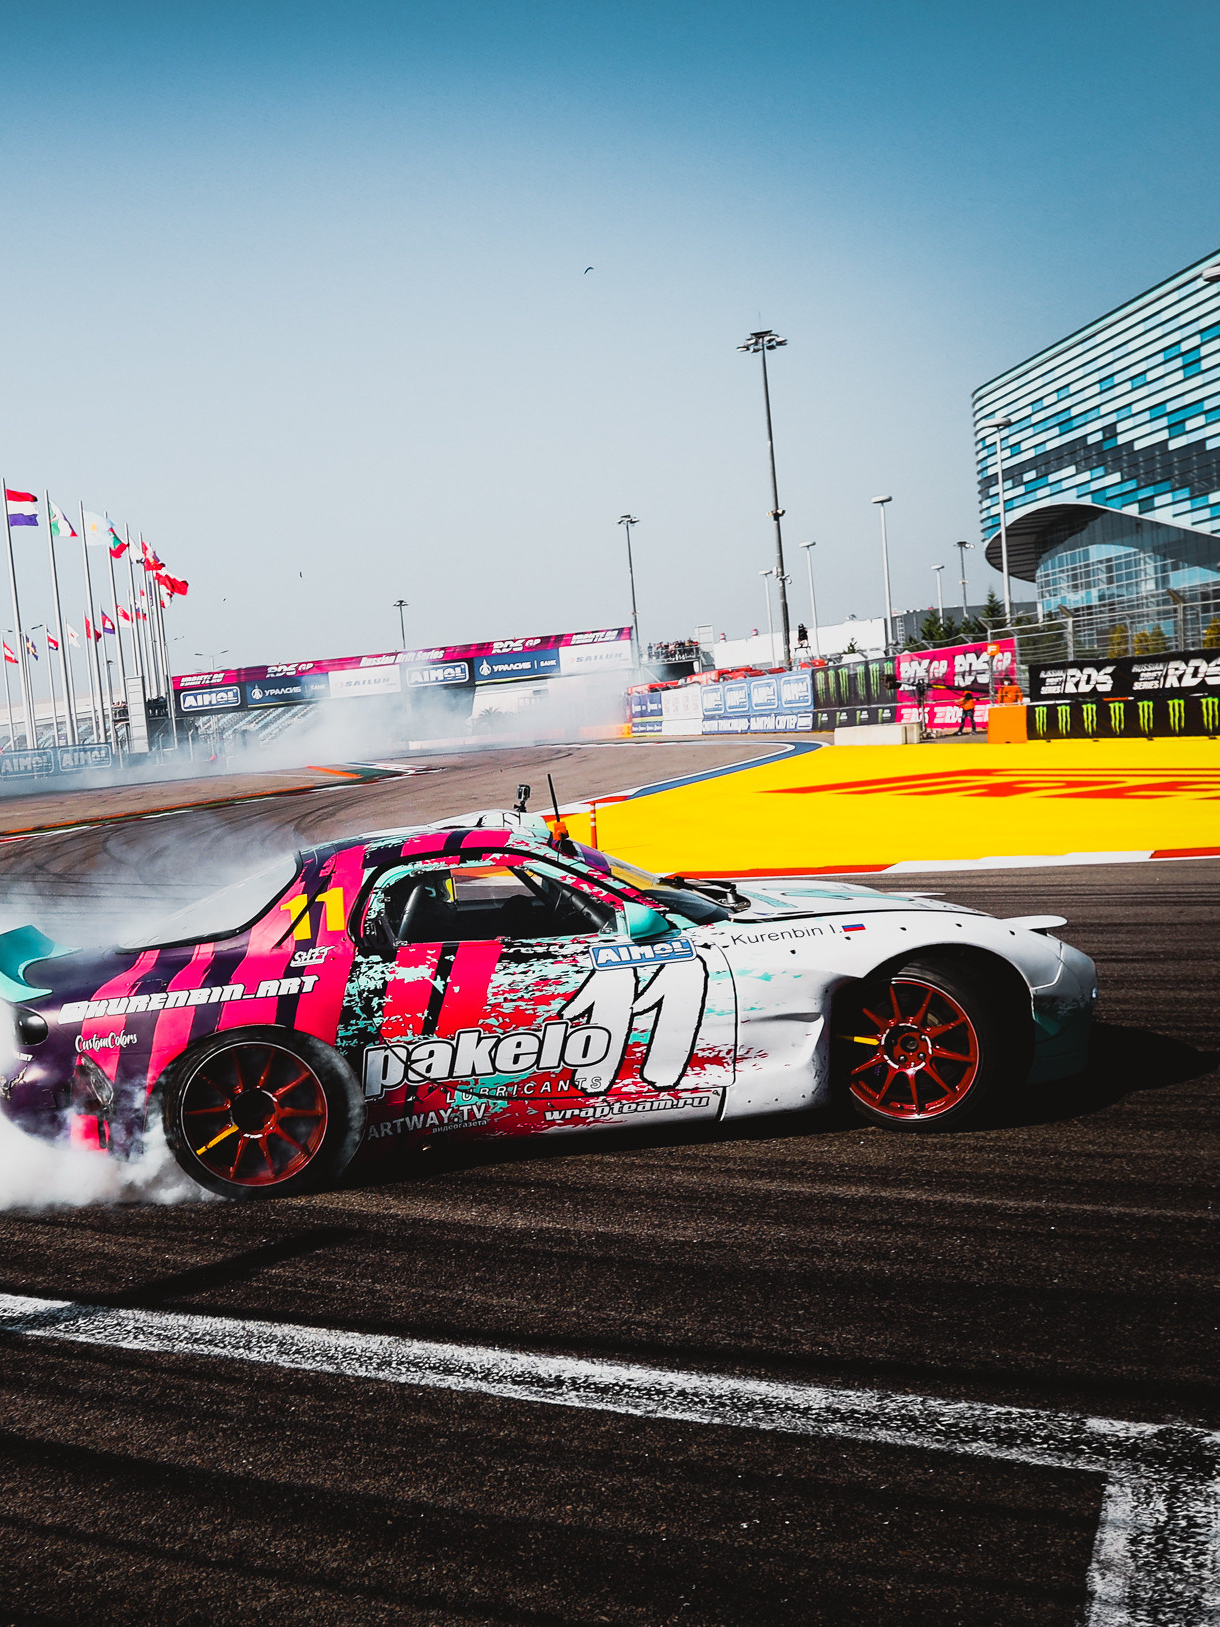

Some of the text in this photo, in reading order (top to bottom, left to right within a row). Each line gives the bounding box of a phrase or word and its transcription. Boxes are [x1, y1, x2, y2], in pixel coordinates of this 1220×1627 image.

[492, 638, 541, 654] RDS GP
[359, 649, 445, 667] Russian Drift Series
[492, 661, 532, 673] УРАЛСИБ
[265, 663, 314, 678] RDS GP
[410, 665, 467, 684] AIMOL
[953, 651, 1012, 687] RDS GP
[345, 677, 391, 687] SAILUN
[1064, 666, 1116, 694] RDS
[184, 688, 238, 707] AIMOL
[264, 686, 302, 697] УРАЛСИБ
[1, 755, 52, 773] AIMOL
[61, 750, 109, 766] AIMOL
[280, 887, 345, 940] 11
[730, 926, 824, 946] Kurenbin
[595, 939, 692, 965] AIMOL
[556, 954, 710, 1097] 11
[74, 1029, 138, 1053] CustomColors
[363, 1019, 614, 1099] pakelo
[446, 1076, 603, 1104] LUBRICANTS
[544, 1095, 711, 1122] wrapteam.ru
[367, 1102, 487, 1141] ARTWAY.TV
[432, 1118, 488, 1134] видеогазета
